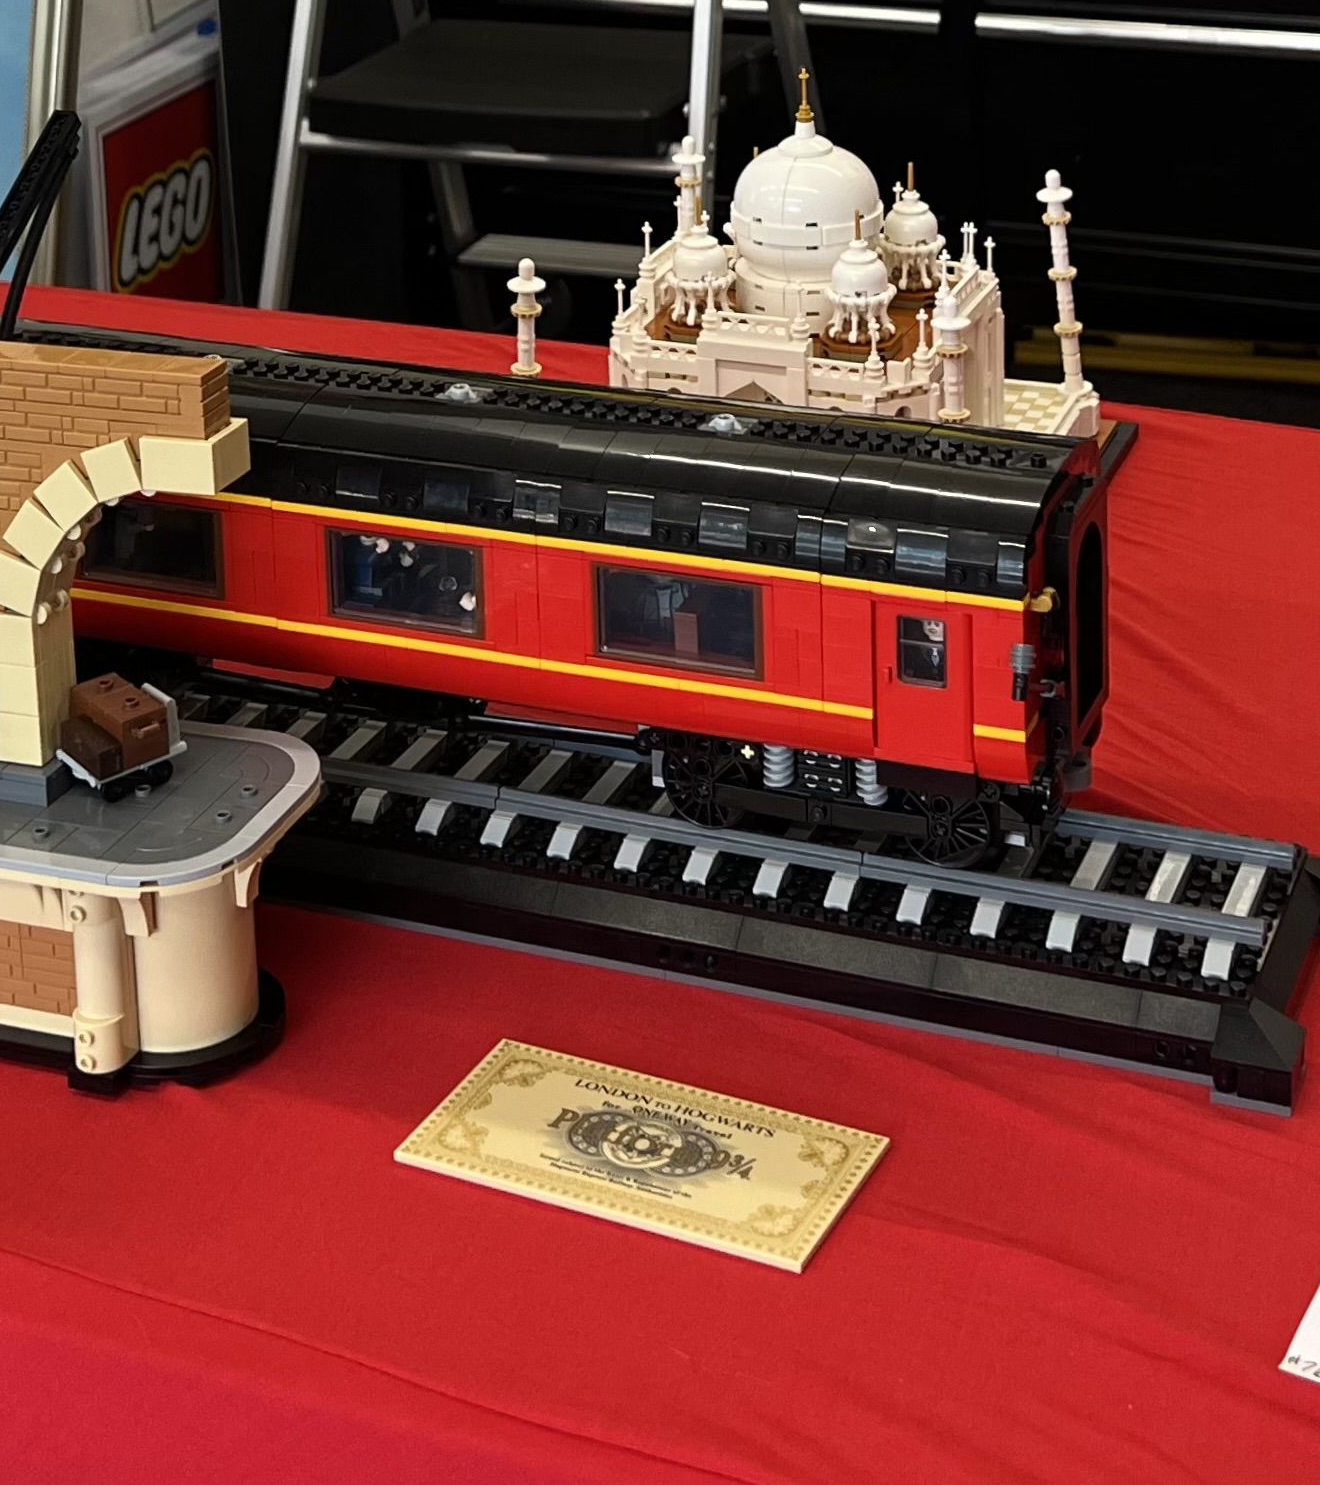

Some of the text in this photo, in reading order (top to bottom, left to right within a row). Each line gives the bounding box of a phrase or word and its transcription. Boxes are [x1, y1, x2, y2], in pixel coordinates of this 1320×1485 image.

[118, 155, 213, 291] LEGO
[575, 1079, 777, 1138] LONDON TO HOGWARTS
